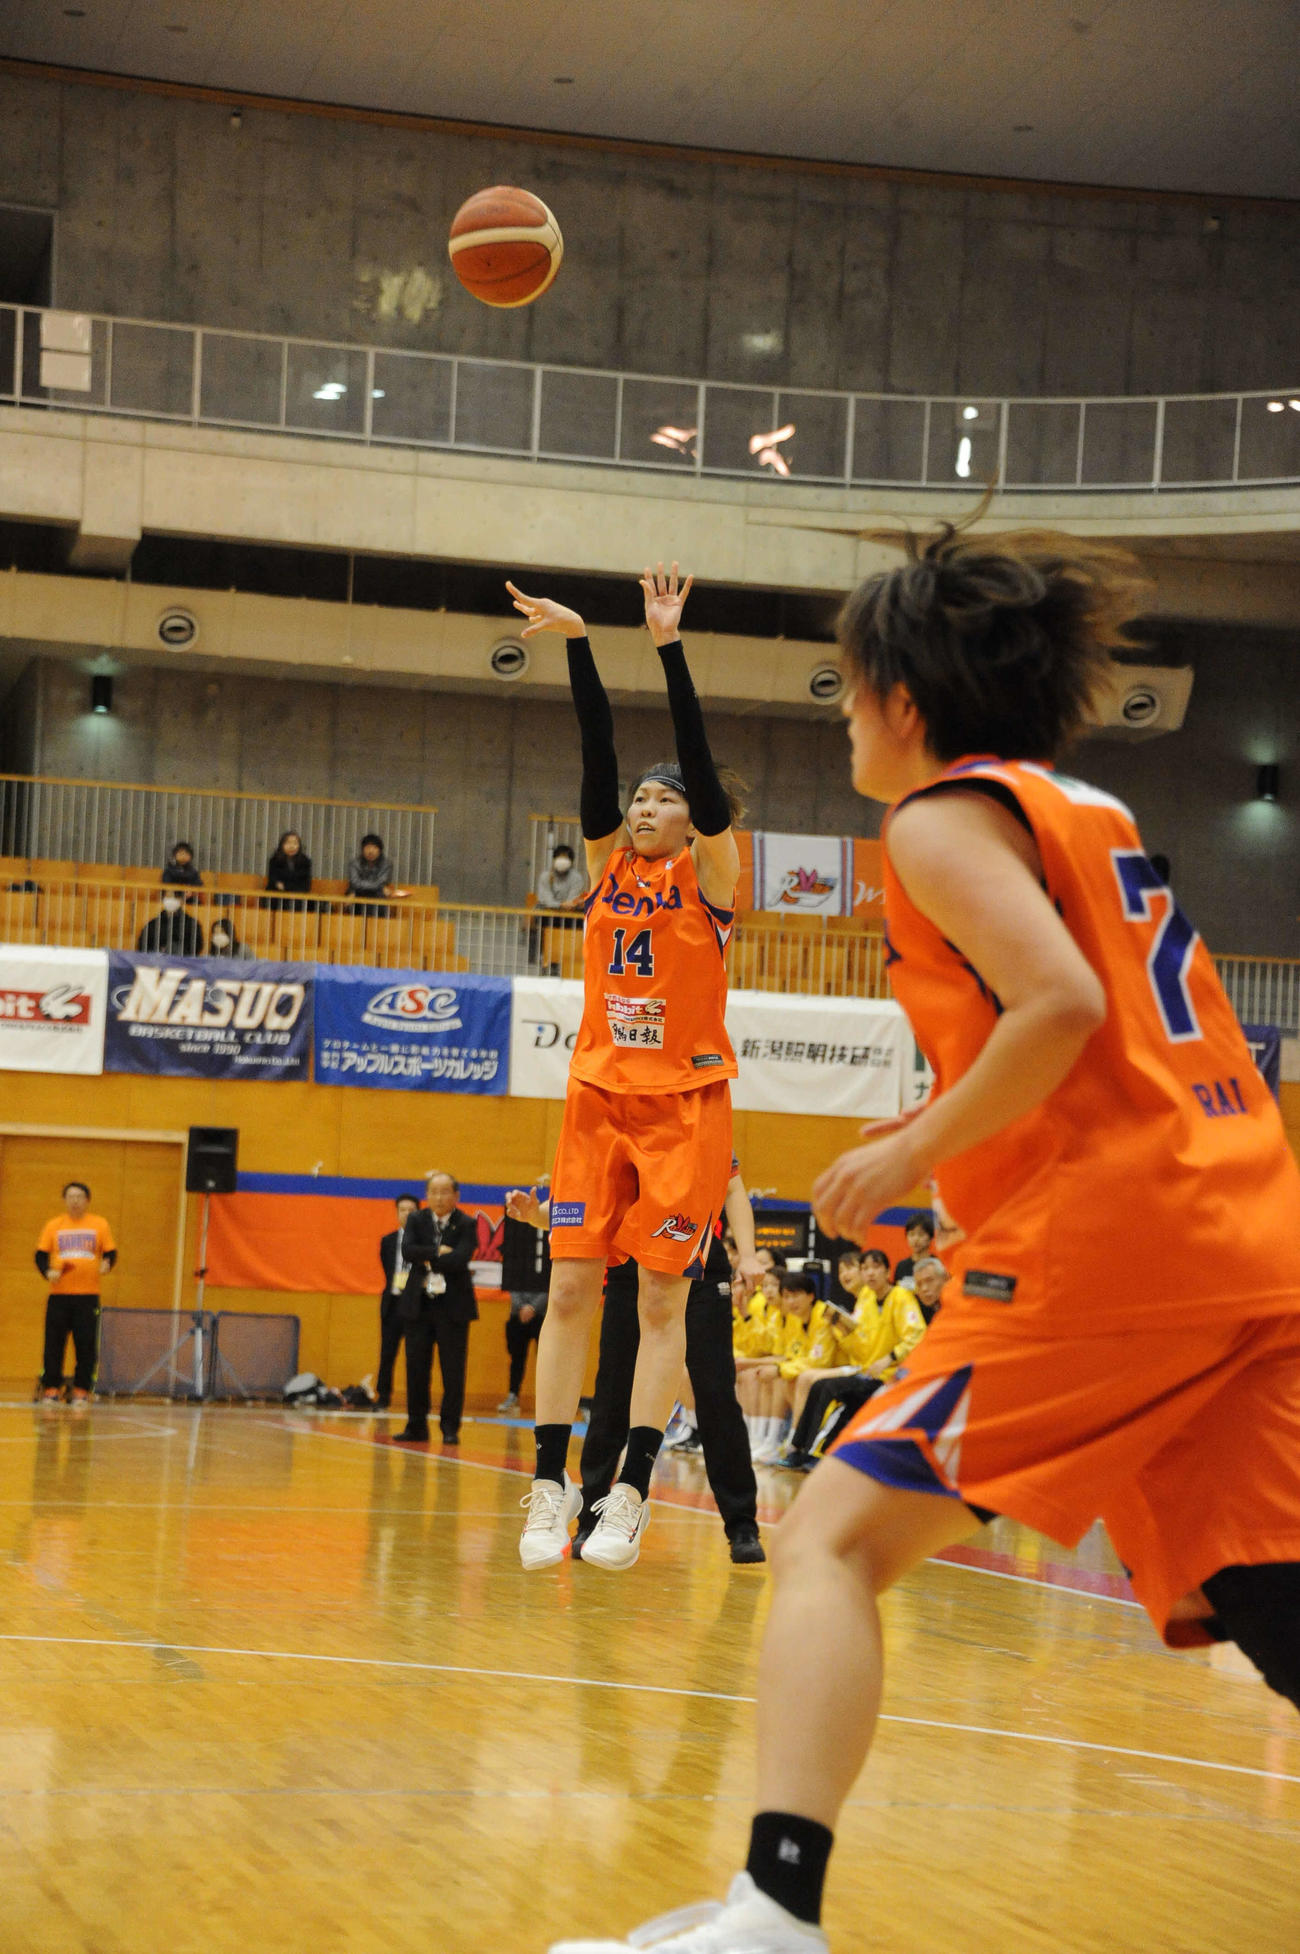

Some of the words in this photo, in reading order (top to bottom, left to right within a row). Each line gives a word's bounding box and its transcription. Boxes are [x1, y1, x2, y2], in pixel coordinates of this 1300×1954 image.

[608, 927, 654, 977] 14
[0, 992, 37, 1019] it
[117, 966, 305, 1031] MASUO
[365, 983, 461, 1019] ASC
[128, 1024, 238, 1043] BASKETBALL
[243, 1032, 292, 1046] CLUB
[1191, 1078, 1248, 1118] RAI
